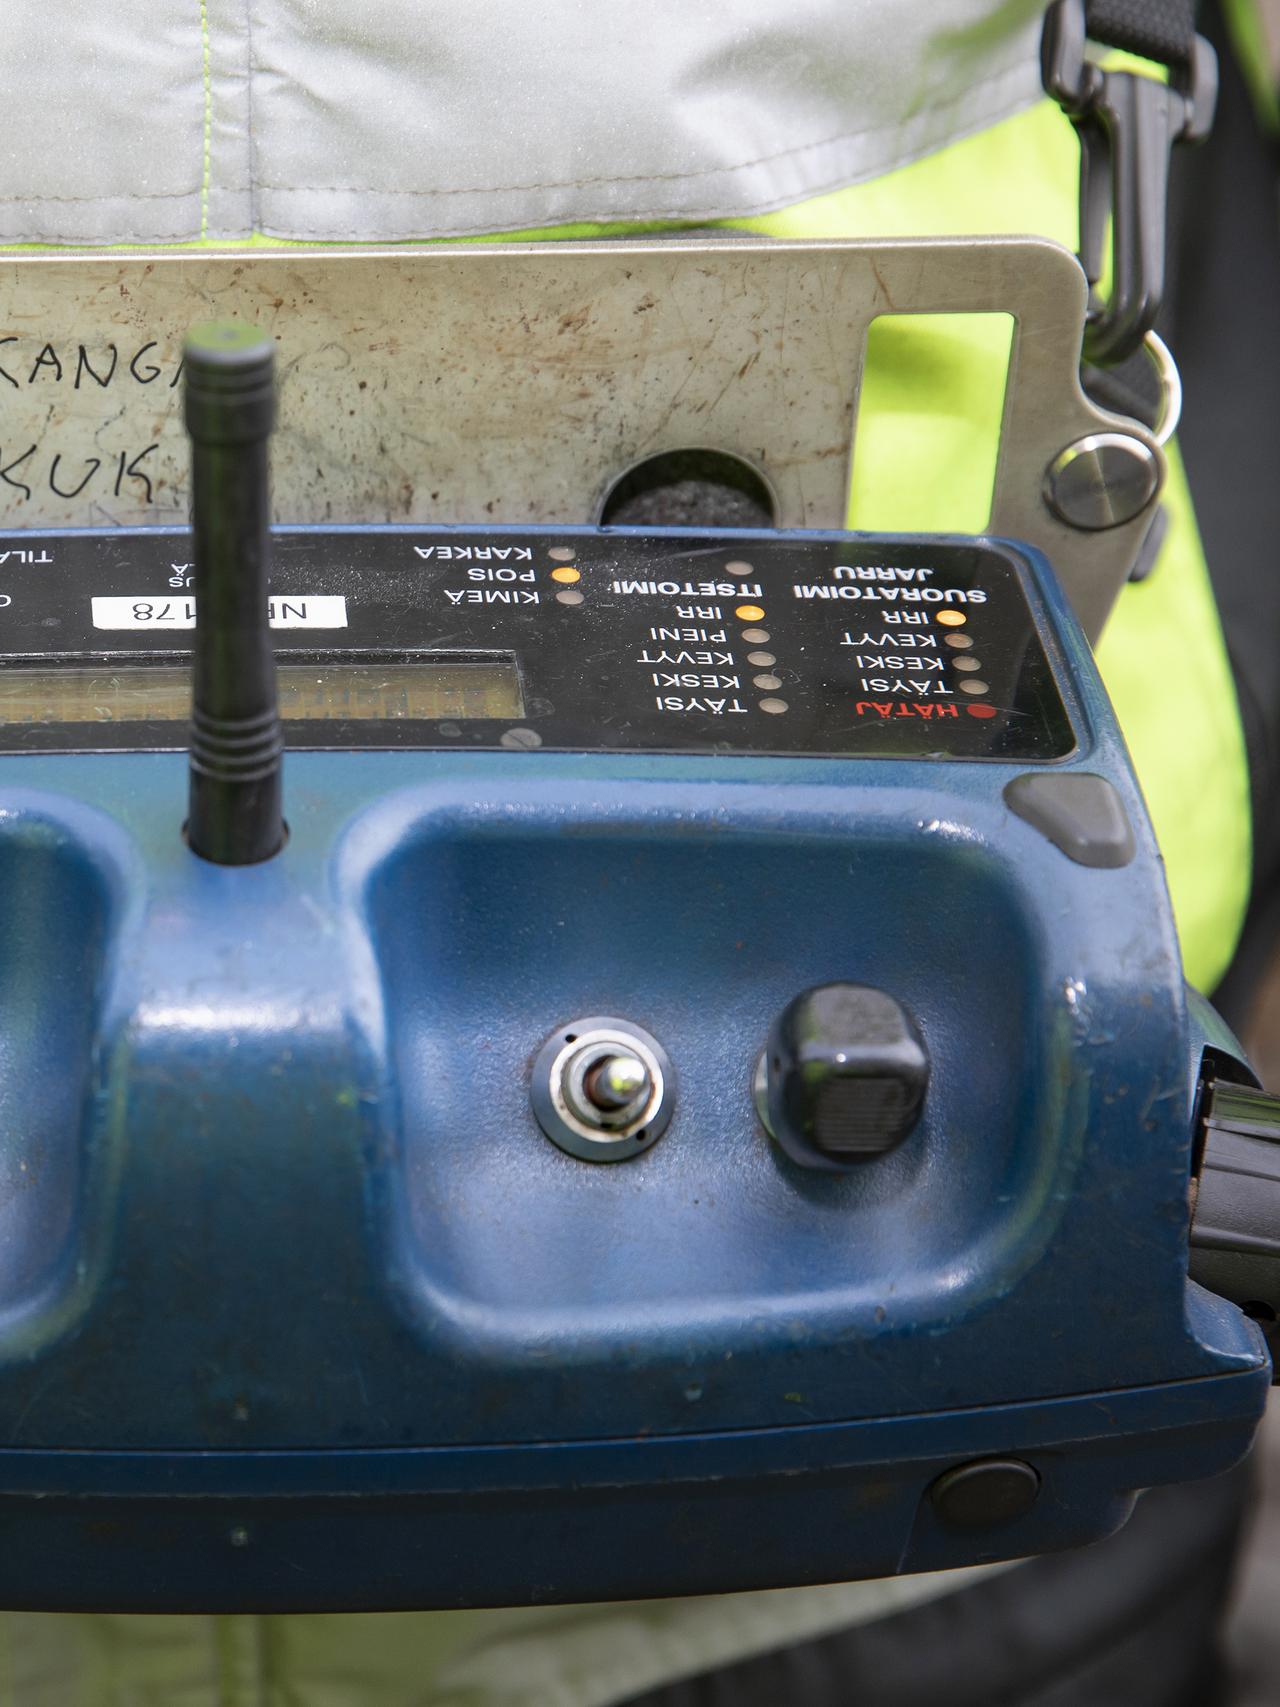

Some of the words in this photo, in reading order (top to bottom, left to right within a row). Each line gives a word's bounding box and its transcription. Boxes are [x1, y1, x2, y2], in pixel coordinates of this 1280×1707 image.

[413, 546, 532, 561] KARKEA
[468, 568, 535, 582] POIS
[833, 565, 934, 582] JARRU
[612, 580, 763, 598] ITSETOIMI
[794, 585, 987, 603] SUORATOIMI
[444, 590, 540, 605] KIMEÄ
[675, 605, 722, 620] IRR
[882, 611, 929, 624] IRR
[650, 627, 726, 643] PIENI
[840, 632, 937, 647] KEVYT
[636, 649, 733, 665] KEVYT
[856, 655, 945, 670] KESKI
[653, 673, 740, 689] KESKI
[860, 678, 953, 694] TÄYSI
[655, 696, 748, 713] TÄYSI
[855, 701, 959, 718] HÄTÄJ
